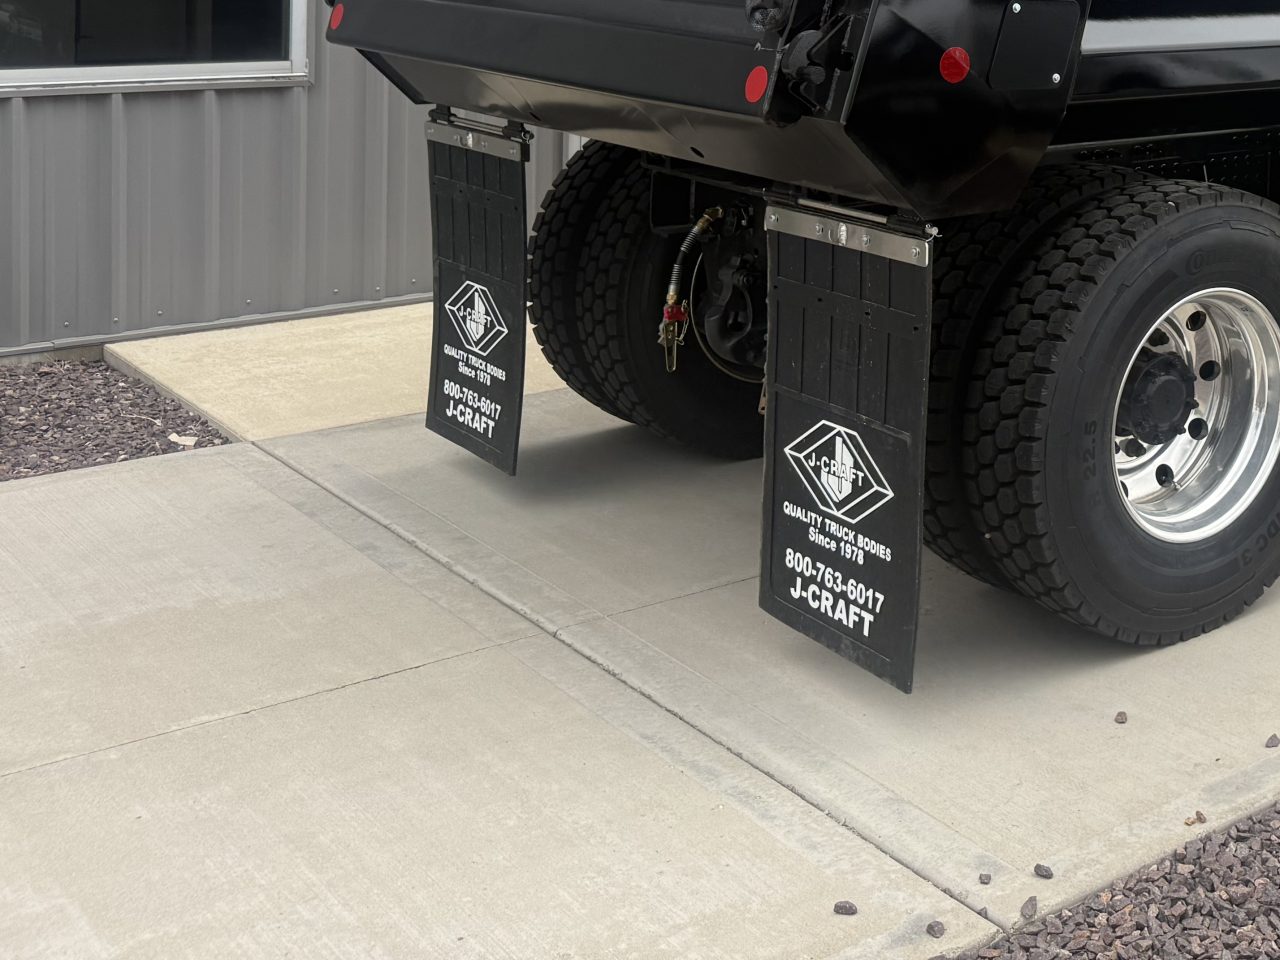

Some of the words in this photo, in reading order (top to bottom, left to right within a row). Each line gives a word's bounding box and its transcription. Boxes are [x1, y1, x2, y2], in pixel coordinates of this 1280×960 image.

[459, 305, 492, 328] J-CRAFT
[444, 343, 467, 362] QUALITY
[468, 354, 487, 371] TRUCK
[487, 363, 506, 381] BODIES
[458, 361, 475, 378] Since
[476, 369, 491, 386] 1978
[443, 378, 502, 420] 800-763-6017
[446, 400, 495, 438] J-CRAFT
[808, 452, 865, 487] J-CRAFT
[783, 501, 823, 528] QUALITY
[825, 518, 856, 544] TRUCK
[857, 533, 892, 562] BODIES
[808, 526, 837, 552] Since
[839, 540, 865, 565] 1978
[785, 547, 885, 614] 800-763-6017
[790, 576, 875, 637] J-CRAFT
